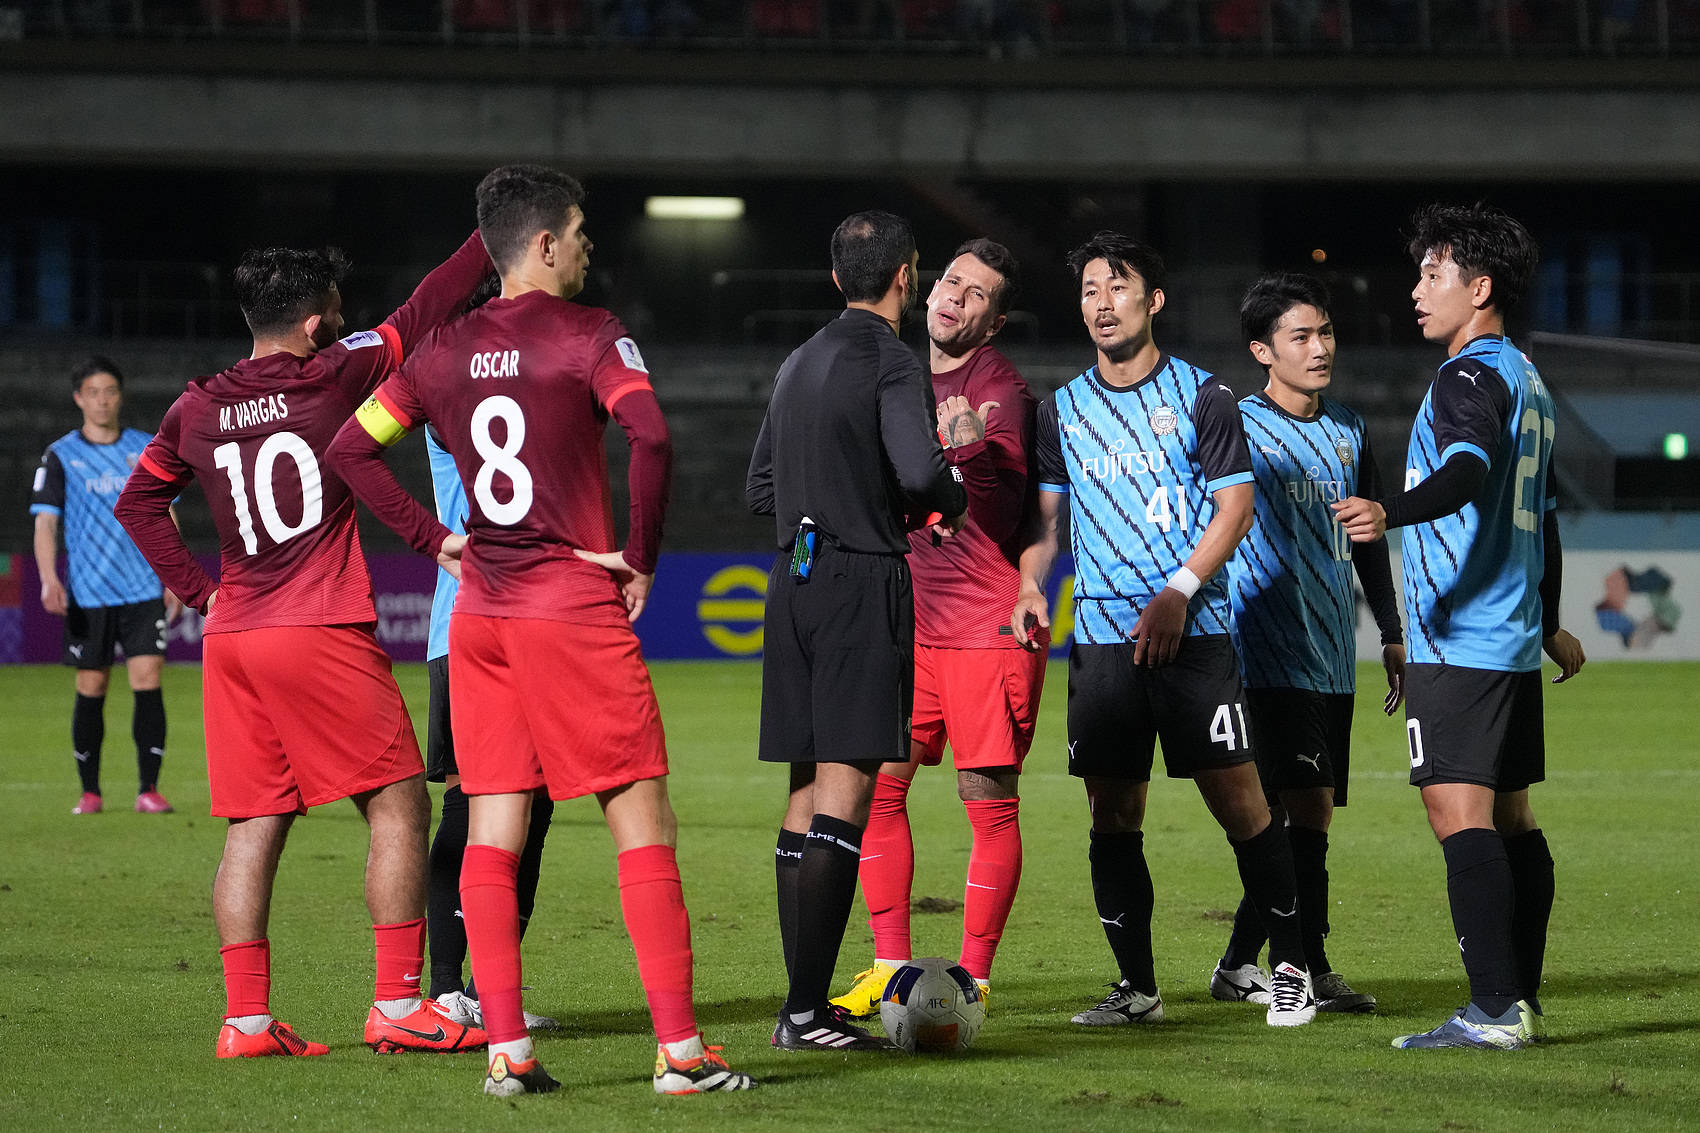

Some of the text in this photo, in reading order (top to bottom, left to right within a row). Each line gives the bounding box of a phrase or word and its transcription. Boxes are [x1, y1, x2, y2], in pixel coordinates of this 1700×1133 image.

[470, 350, 520, 379] OSCAR
[470, 395, 534, 526] 8
[1082, 450, 1166, 485] FUJITSU
[213, 431, 323, 556] 10
[1146, 485, 1188, 532] 41
[1285, 480, 1348, 510] FUJITSU
[1209, 703, 1249, 750] 41
[807, 831, 836, 842] ELME
[776, 847, 803, 859] ELME
[925, 998, 948, 1009] AFC
